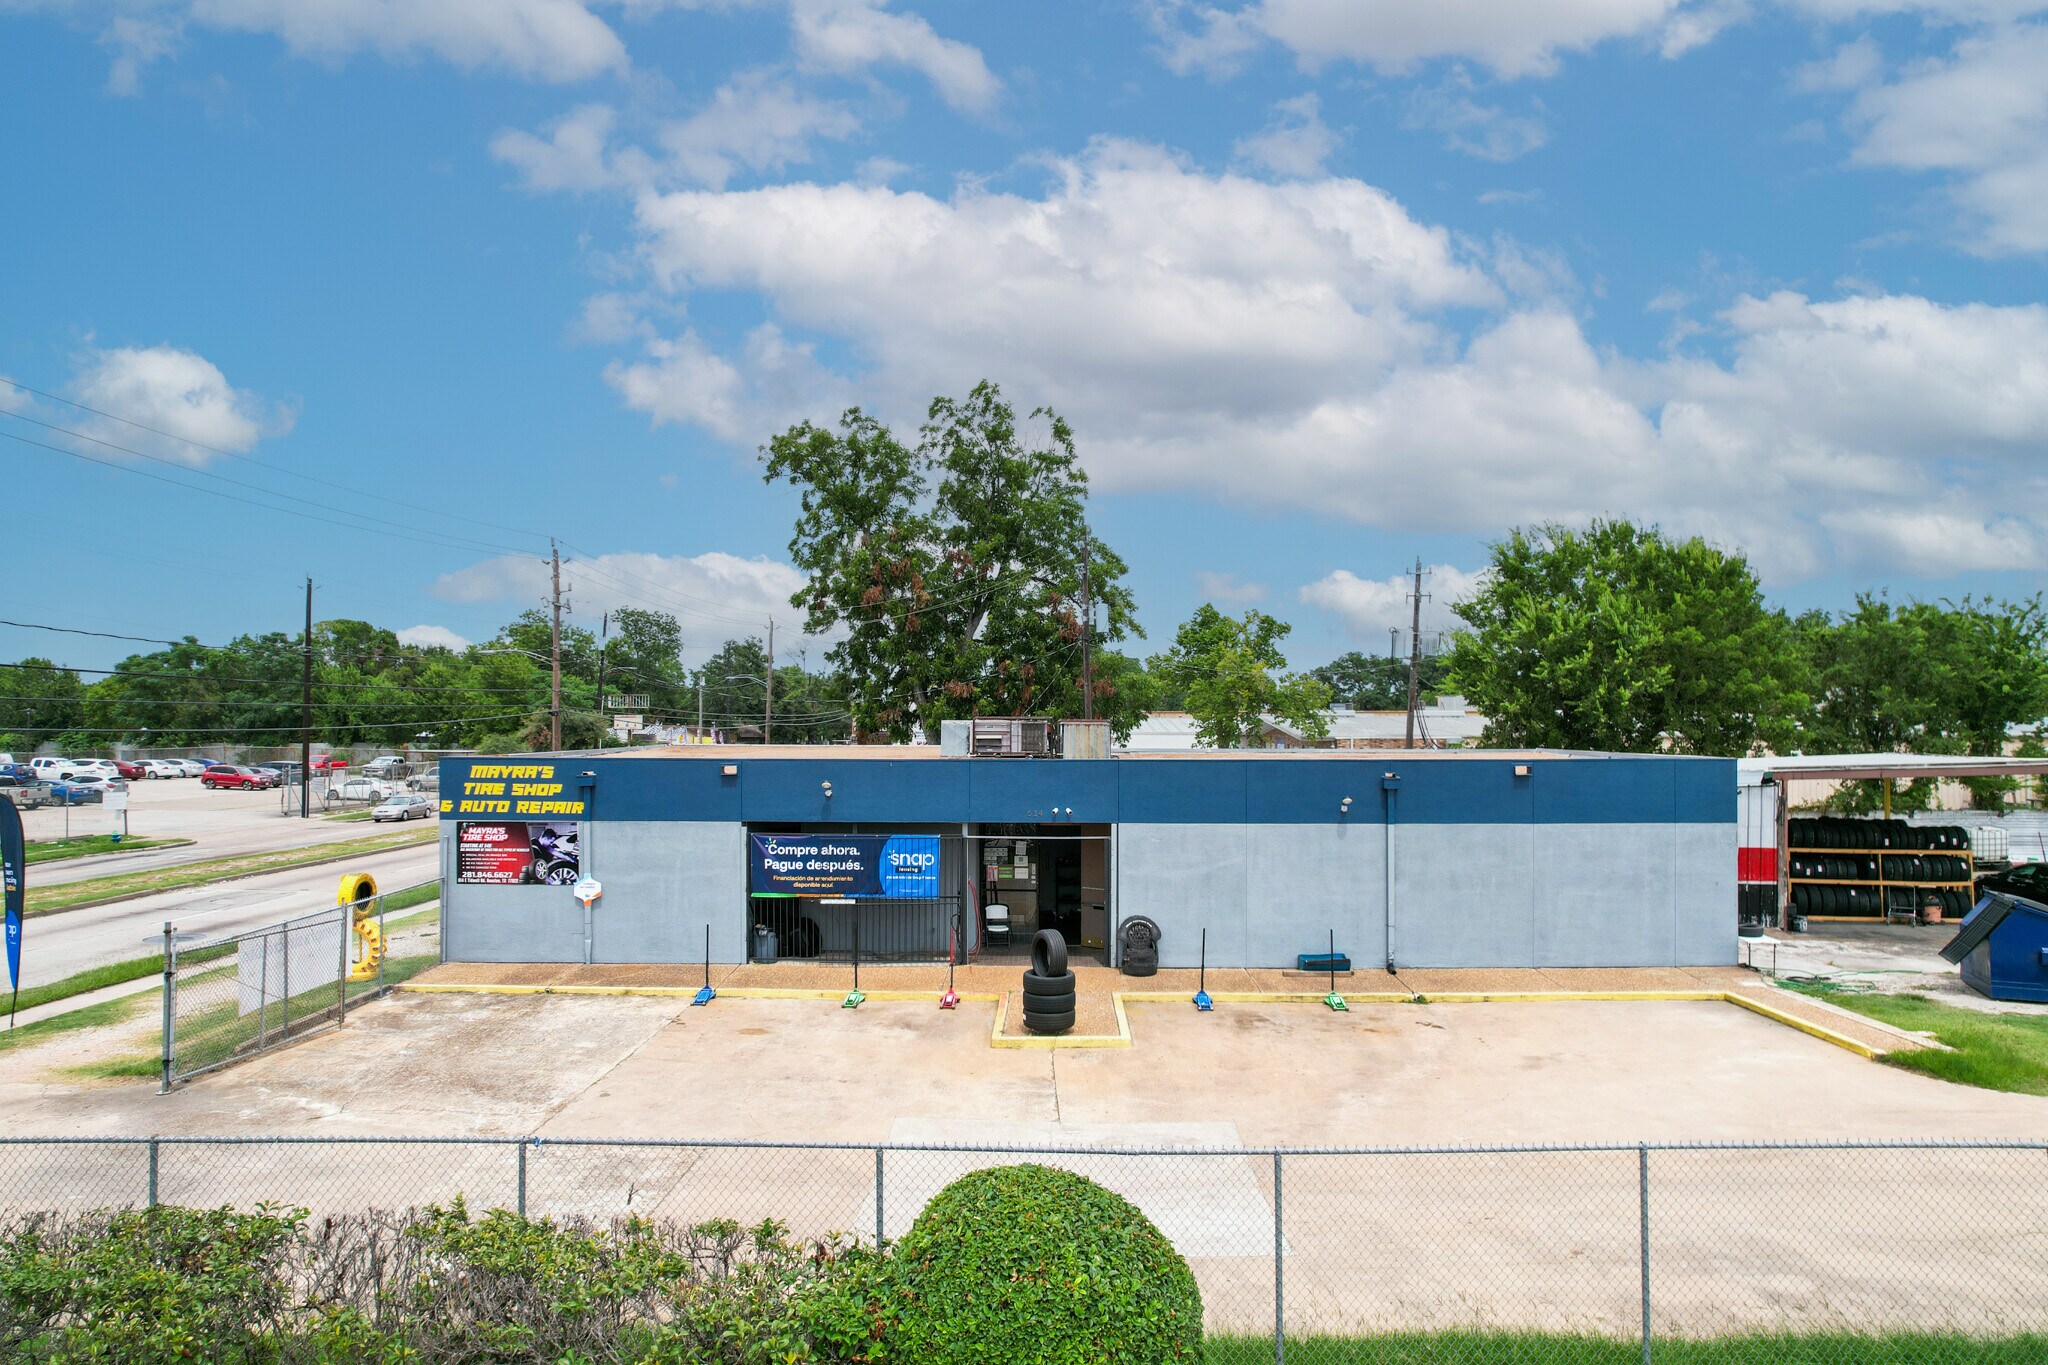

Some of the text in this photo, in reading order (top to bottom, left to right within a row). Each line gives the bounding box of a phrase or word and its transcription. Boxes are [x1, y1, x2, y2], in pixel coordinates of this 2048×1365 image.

[470, 765, 554, 778] MAYRA'S
[464, 783, 563, 796] TIRE SHOP
[440, 800, 585, 814] & AUTO REPAIR
[768, 843, 860, 858] Compre ahora.
[764, 858, 864, 872] Pague después.
[891, 853, 934, 870] snap
